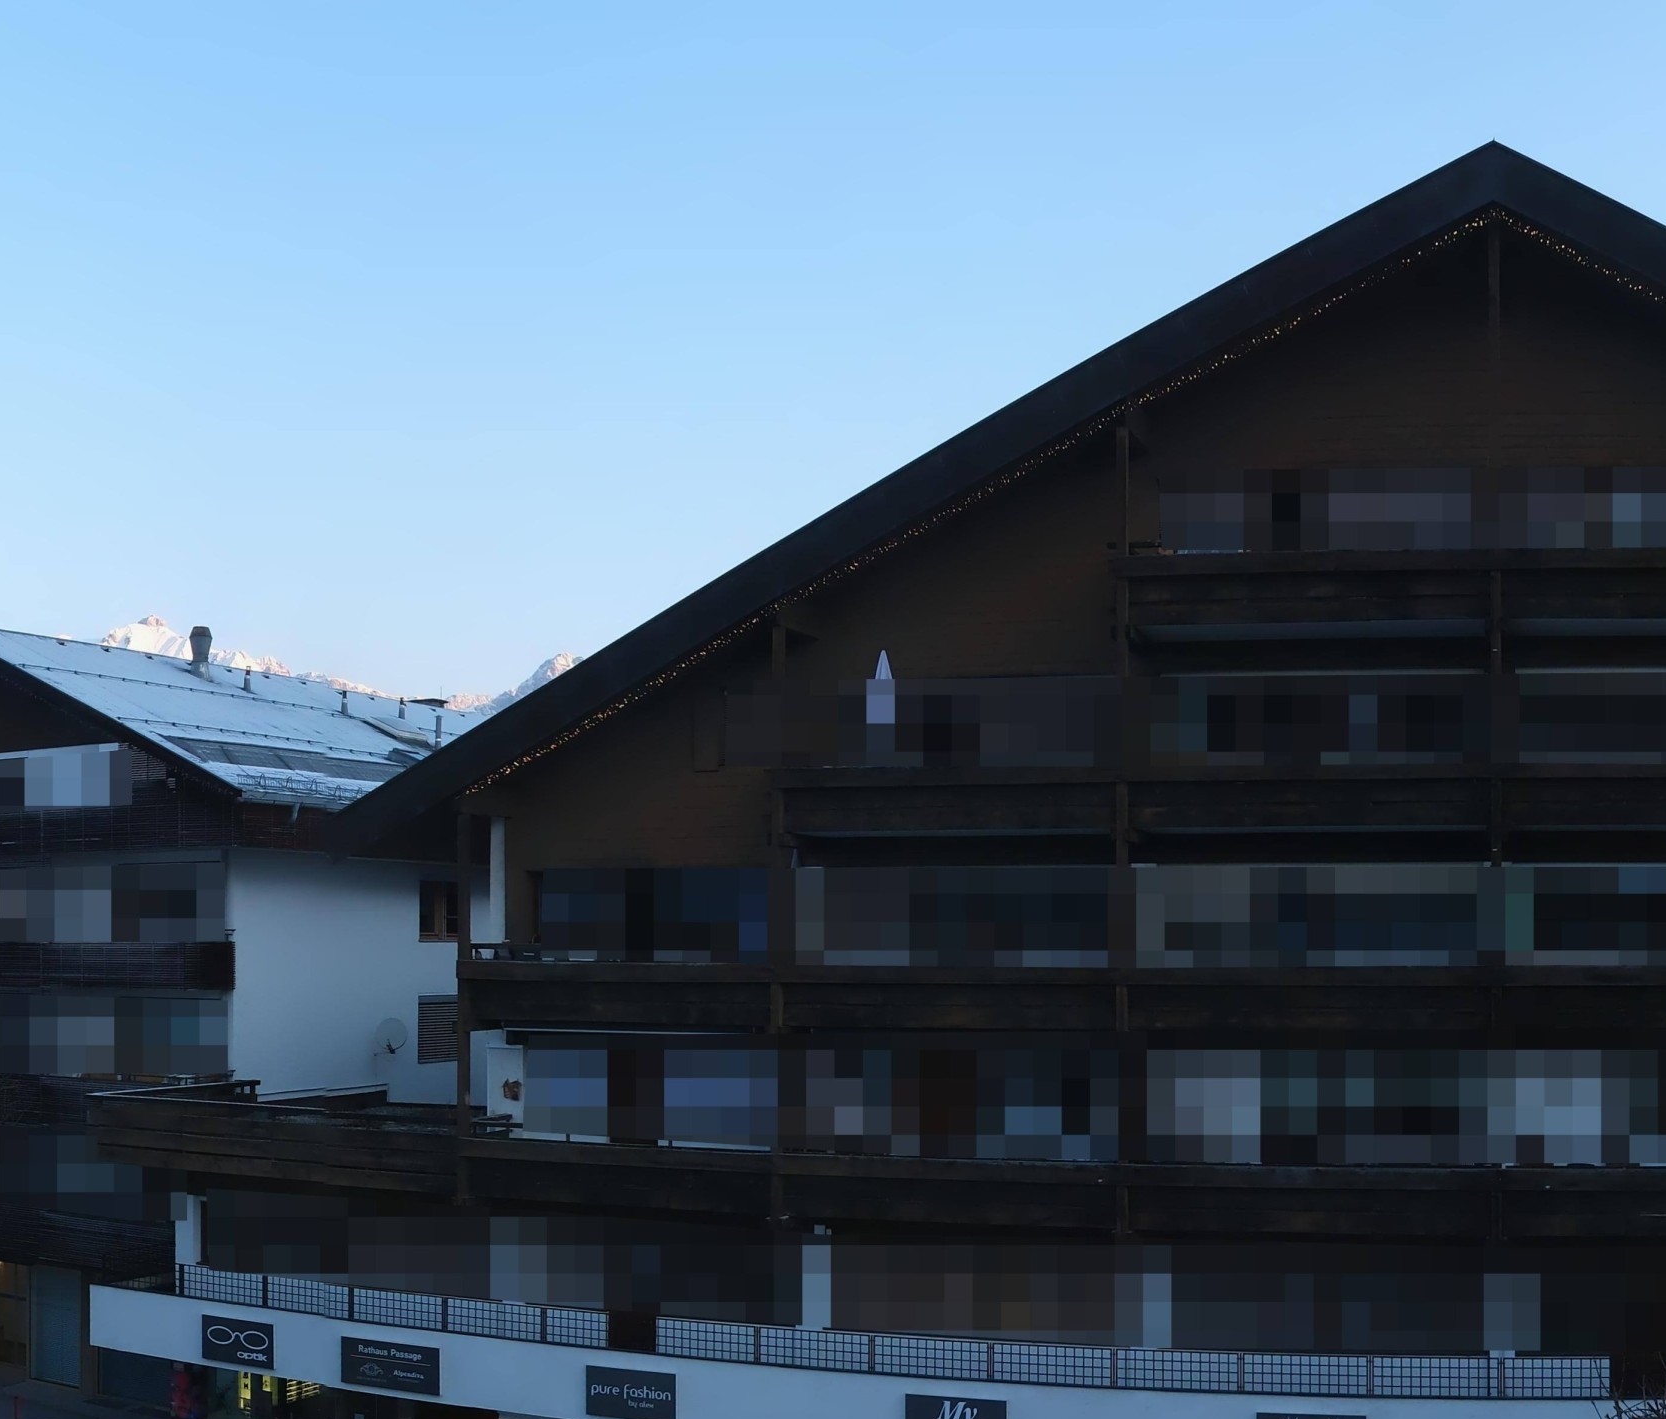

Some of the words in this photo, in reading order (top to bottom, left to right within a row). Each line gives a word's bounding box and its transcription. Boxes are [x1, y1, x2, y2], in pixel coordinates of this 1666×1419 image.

[237, 1351, 268, 1362] optik
[358, 1344, 388, 1357] Rathaus
[391, 1348, 422, 1362] Passage
[591, 1384, 620, 1396] pure
[624, 1384, 671, 1401] fashion
[628, 1400, 638, 1408] by
